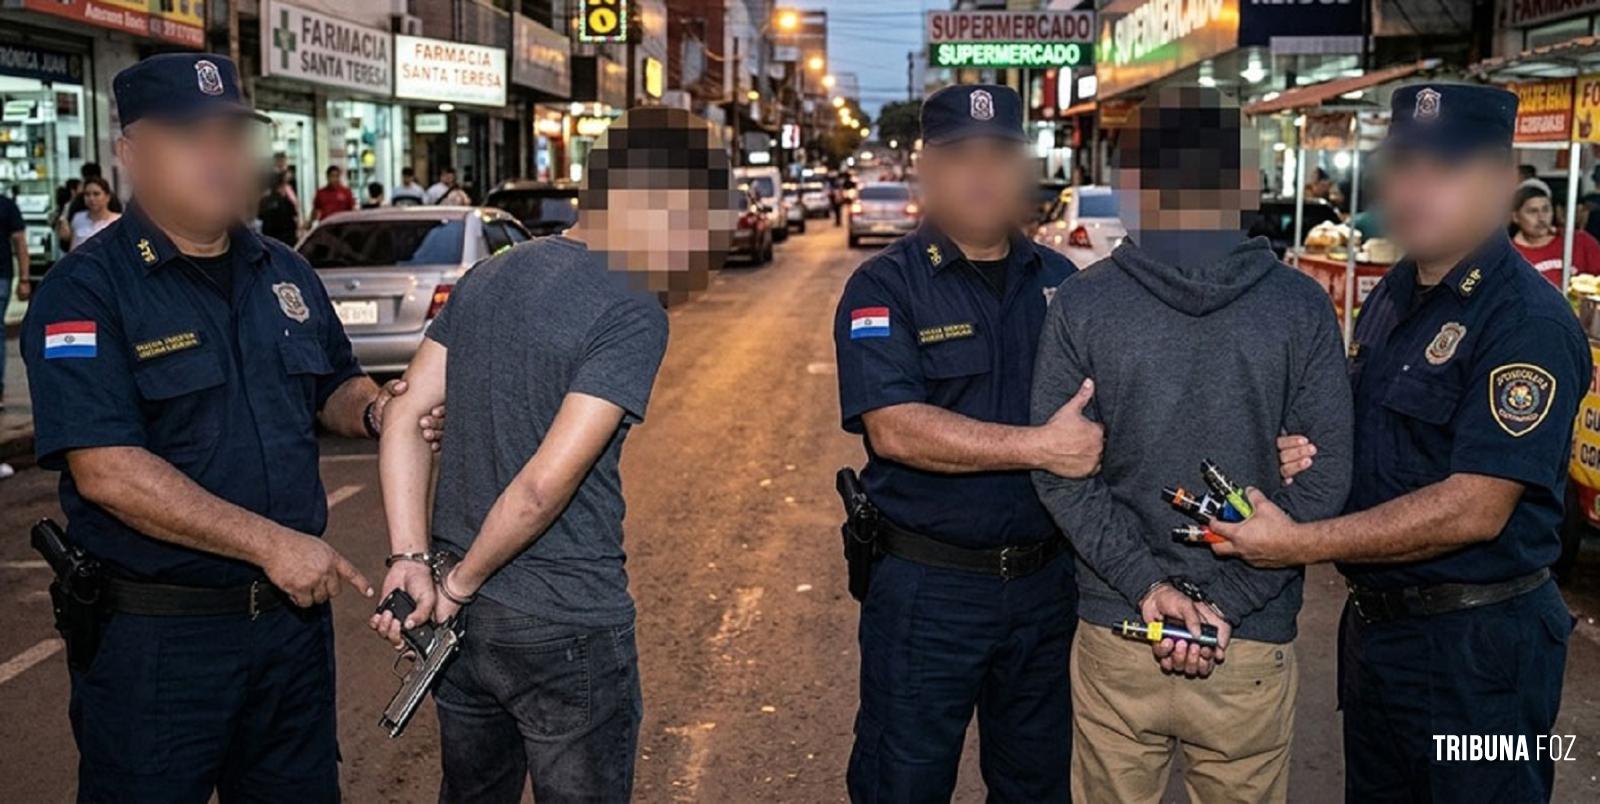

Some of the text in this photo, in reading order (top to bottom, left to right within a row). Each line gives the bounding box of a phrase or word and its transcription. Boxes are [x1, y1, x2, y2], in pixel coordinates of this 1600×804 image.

[301, 15, 388, 62] FARMACIA
[932, 14, 1091, 40] SUPERMERCADO
[414, 42, 492, 67] FARMACIA
[937, 43, 1081, 65] SUPERMERCADO
[300, 50, 388, 87] SANTA TERESA
[402, 63, 502, 89] SANTA TERESA
